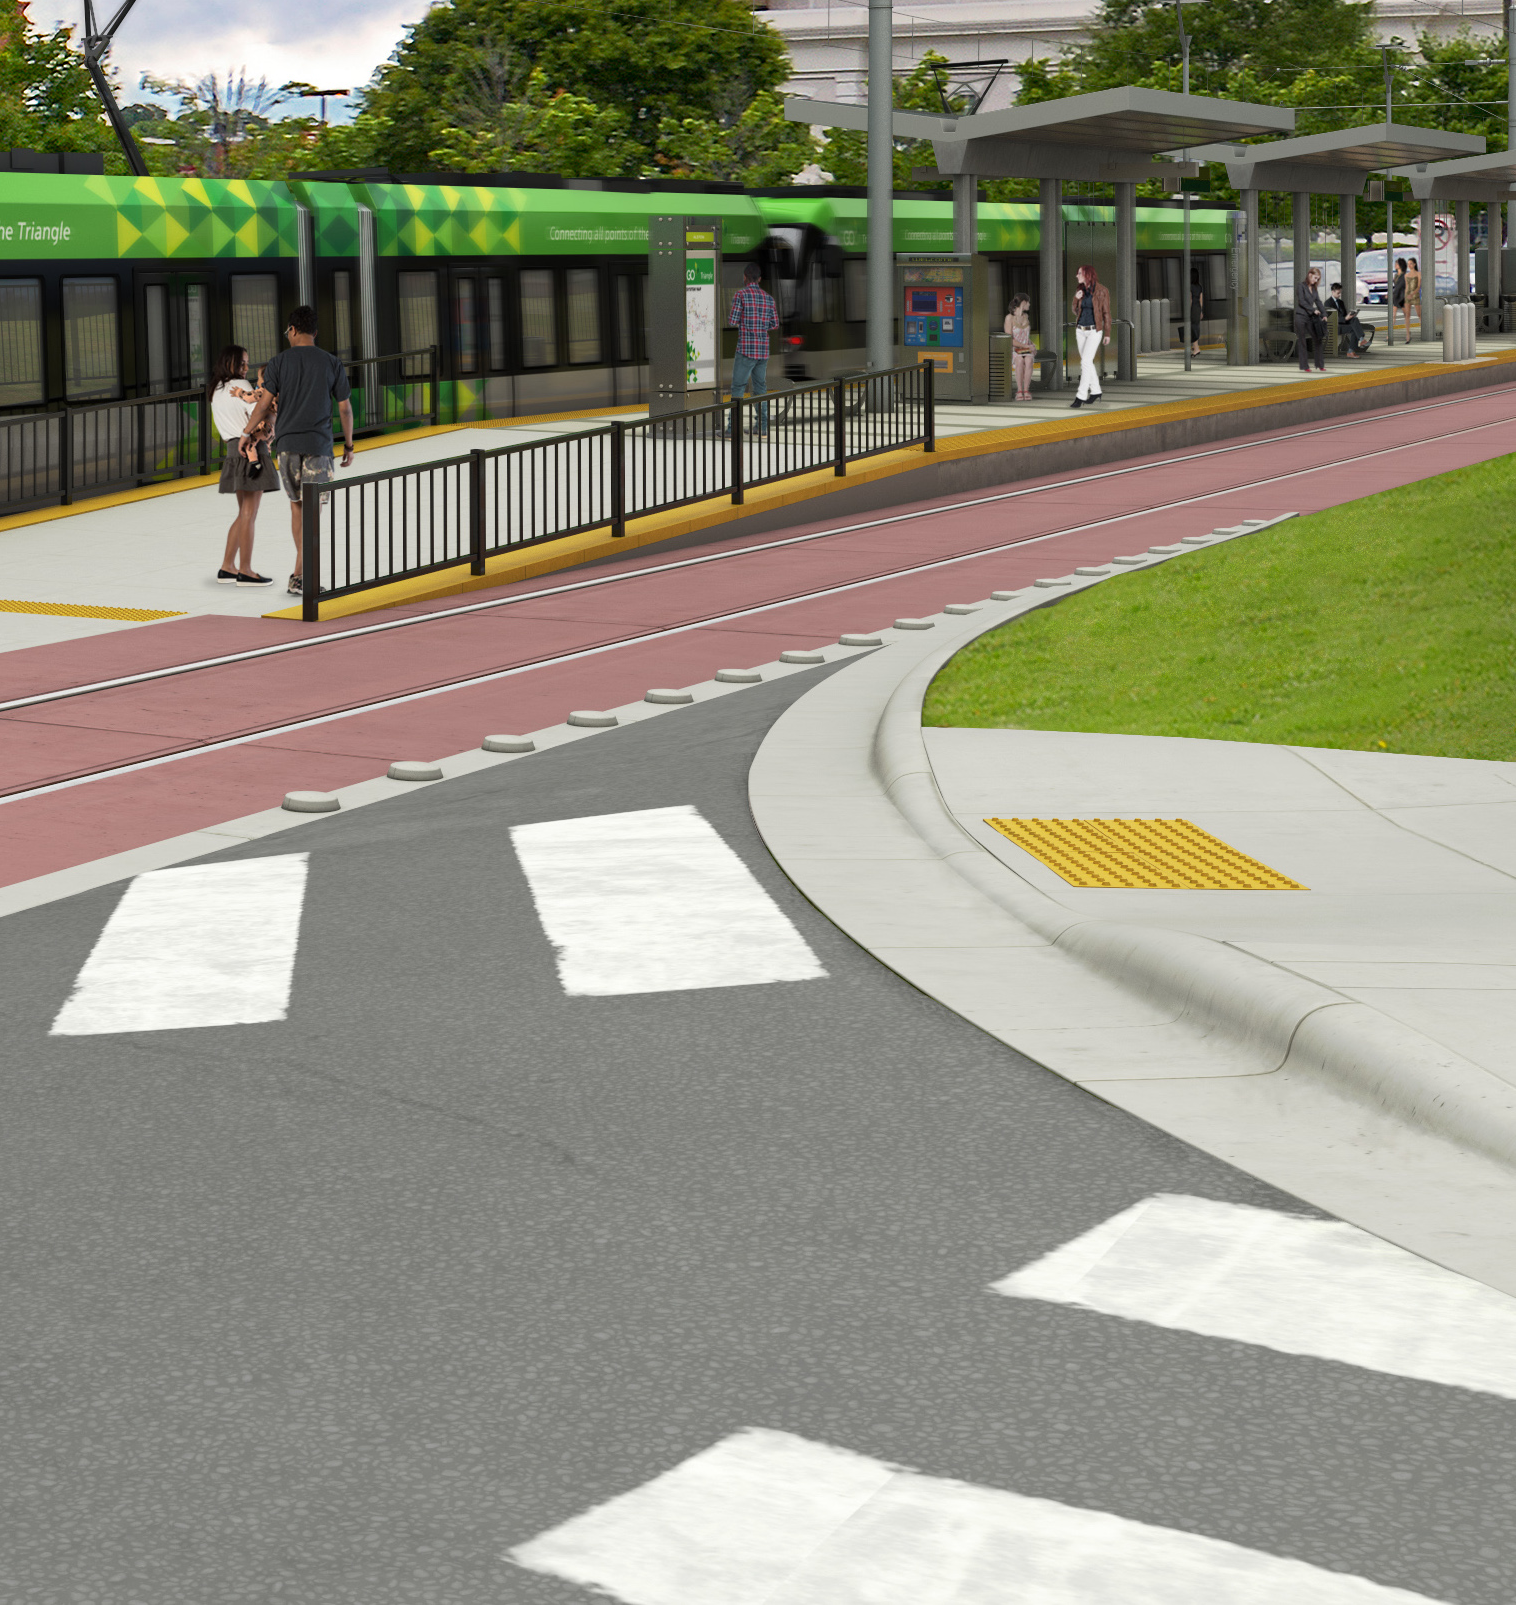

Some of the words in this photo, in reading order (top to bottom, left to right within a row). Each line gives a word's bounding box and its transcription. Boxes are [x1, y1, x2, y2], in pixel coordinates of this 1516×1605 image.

[18, 221, 71, 246] Triangle
[549, 226, 592, 244] Connecting
[593, 226, 604, 241] all
[605, 226, 627, 245] points
[686, 269, 695, 280] GO
[700, 270, 713, 282] Triangle
[1230, 248, 1240, 290] Emergency
